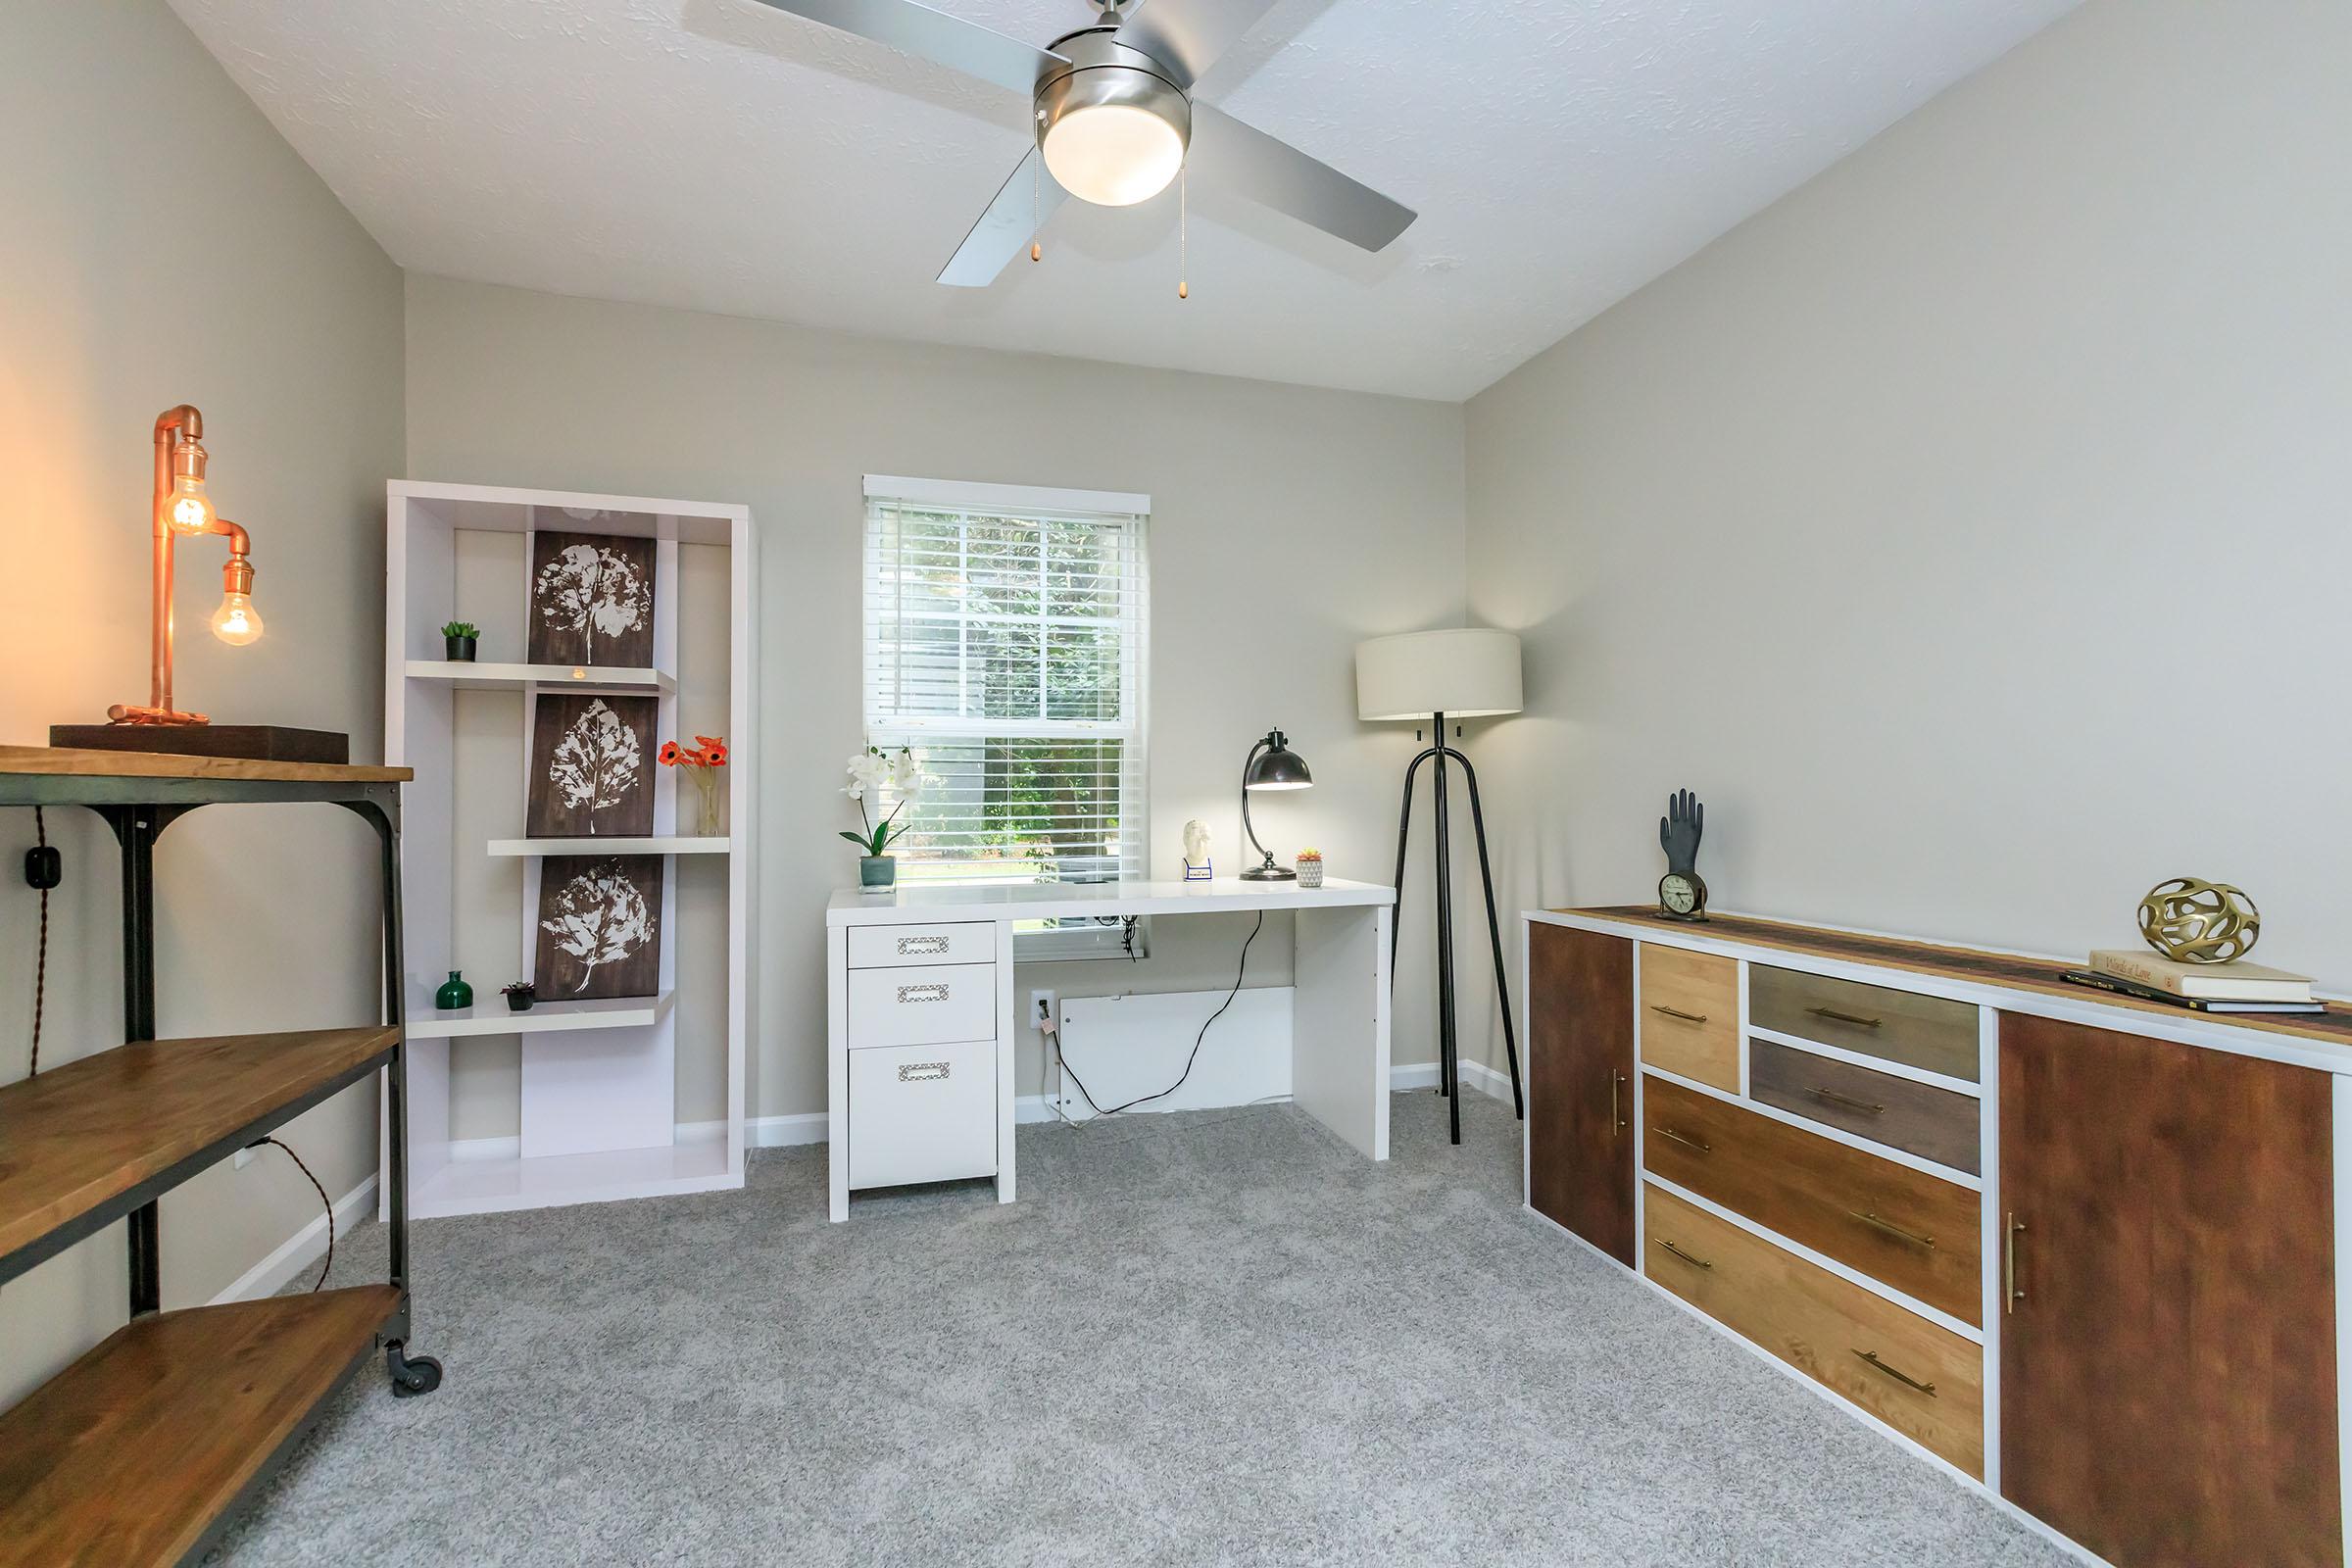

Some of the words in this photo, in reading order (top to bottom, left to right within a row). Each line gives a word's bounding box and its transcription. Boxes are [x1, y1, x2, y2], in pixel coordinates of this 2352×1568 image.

[2106, 956, 2127, 973] Words
[2128, 964, 2135, 975] of
[2134, 964, 2151, 980] Love
